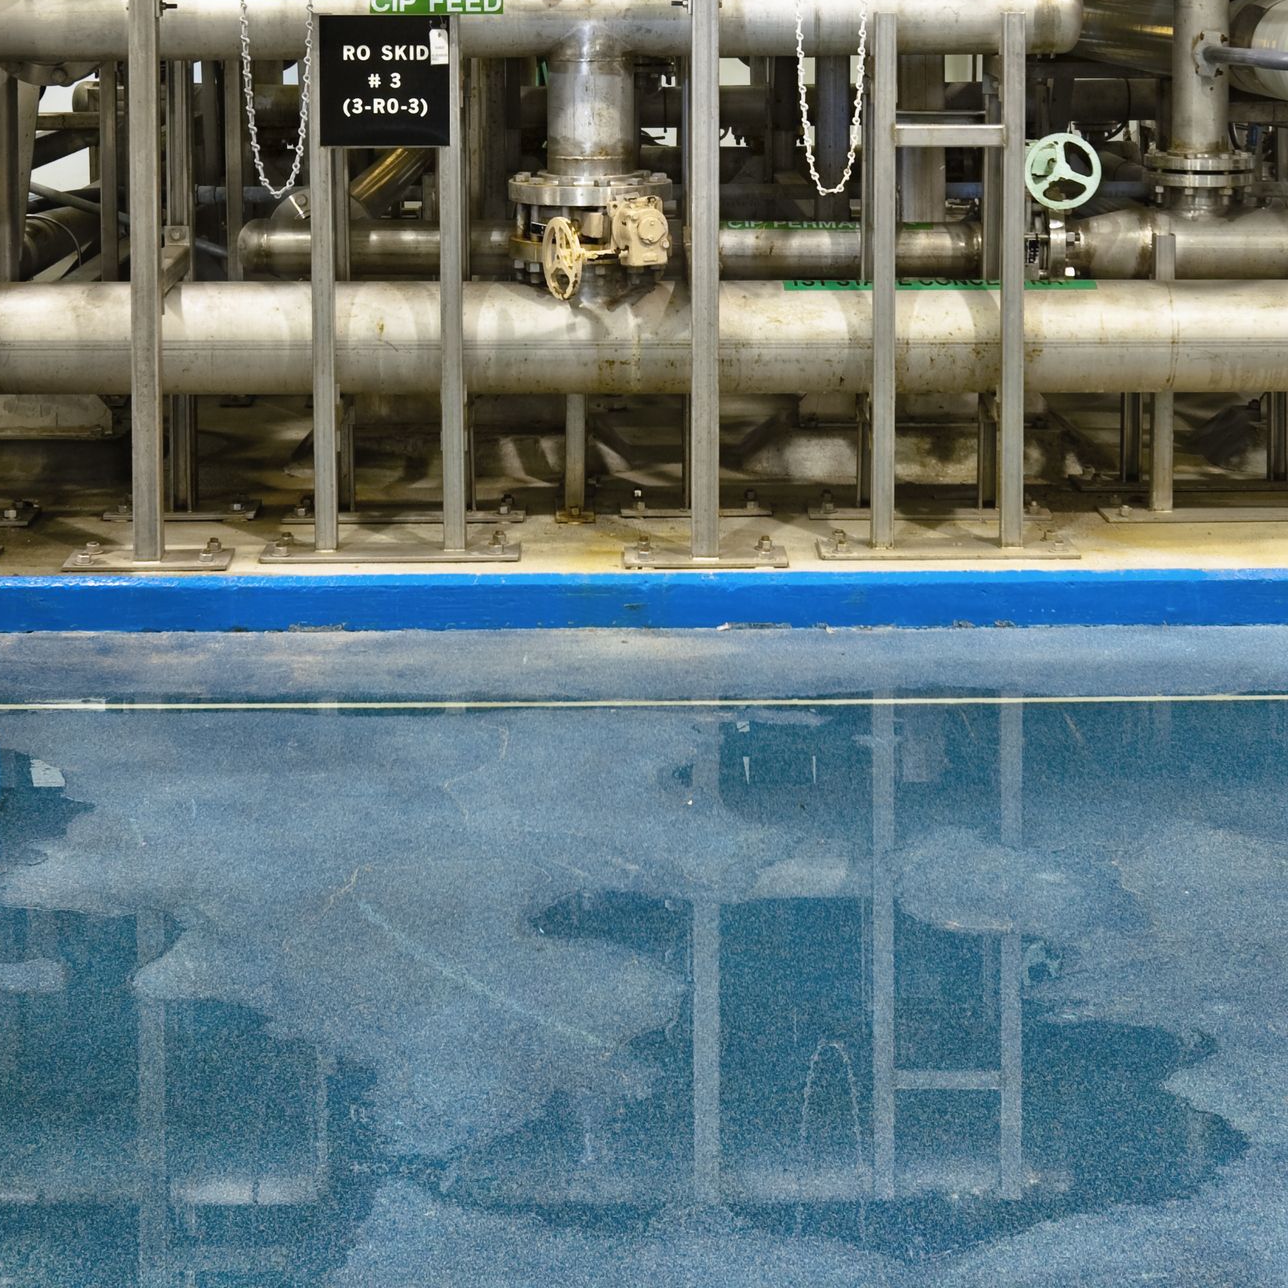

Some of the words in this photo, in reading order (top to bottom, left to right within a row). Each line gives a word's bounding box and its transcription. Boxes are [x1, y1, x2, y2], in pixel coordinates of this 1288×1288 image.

[343, 44, 370, 61] RO
[381, 44, 429, 61] SKID
[368, 73, 381, 88] #
[390, 72, 401, 88] 3
